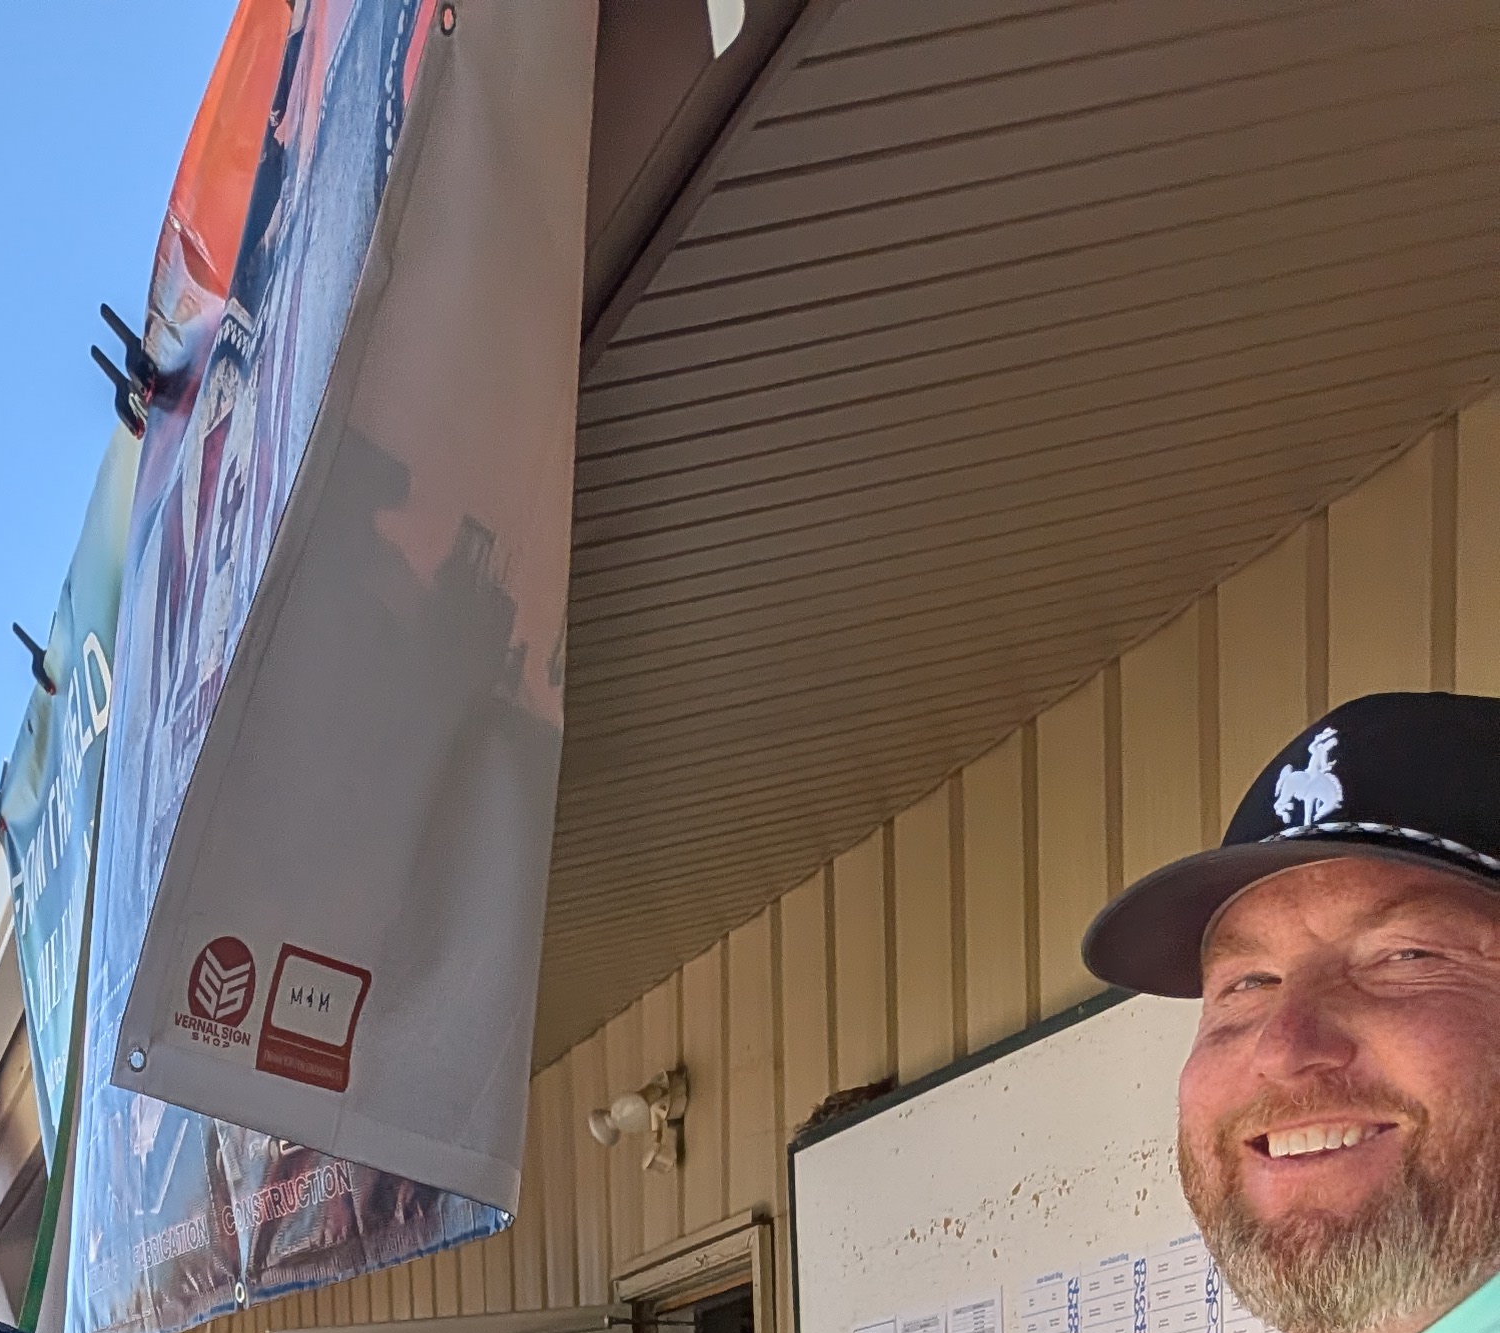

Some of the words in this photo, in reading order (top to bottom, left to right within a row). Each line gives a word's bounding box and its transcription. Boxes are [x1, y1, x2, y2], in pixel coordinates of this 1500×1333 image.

[174, 1011, 220, 1037] VERNAL
[221, 1026, 251, 1046] SIGN
[221, 1161, 354, 1236] CONSTRUCTION
